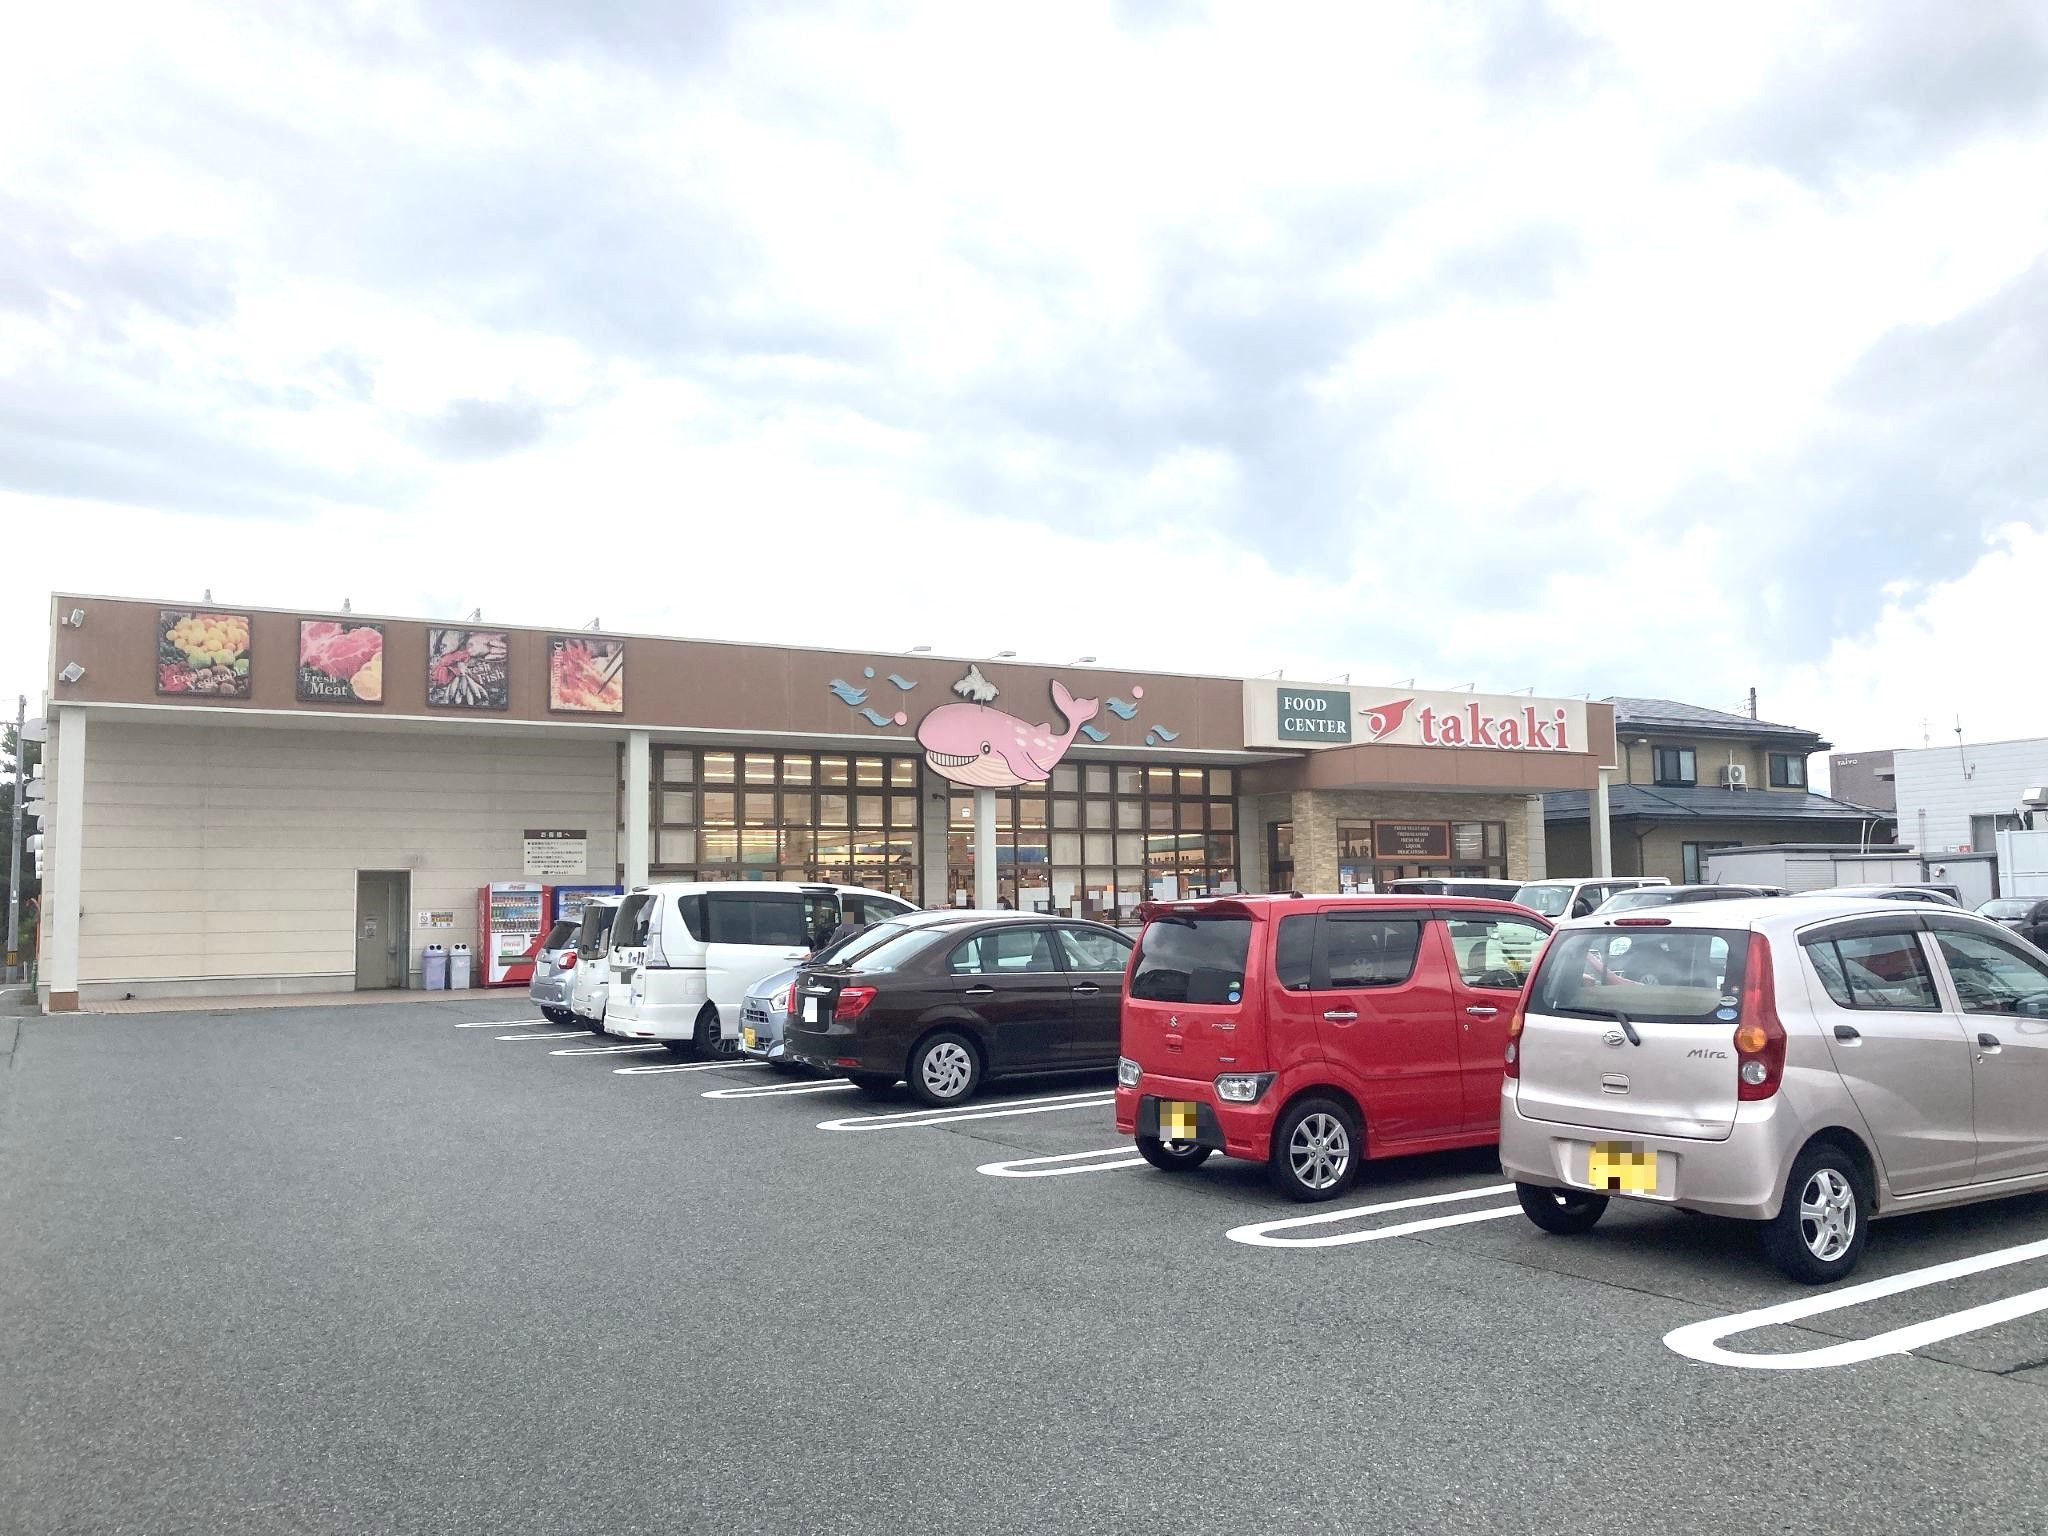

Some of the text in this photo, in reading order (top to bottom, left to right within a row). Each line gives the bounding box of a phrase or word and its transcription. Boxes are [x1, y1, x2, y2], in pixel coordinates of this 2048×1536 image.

[304, 672, 337, 683] Fresh
[477, 667, 505, 685] Fish
[310, 682, 348, 696] Meat
[1283, 697, 1327, 711] FOOD
[1284, 717, 1347, 734] CENTER
[1419, 702, 1569, 749] takaki
[1686, 1049, 1728, 1059] Mira
